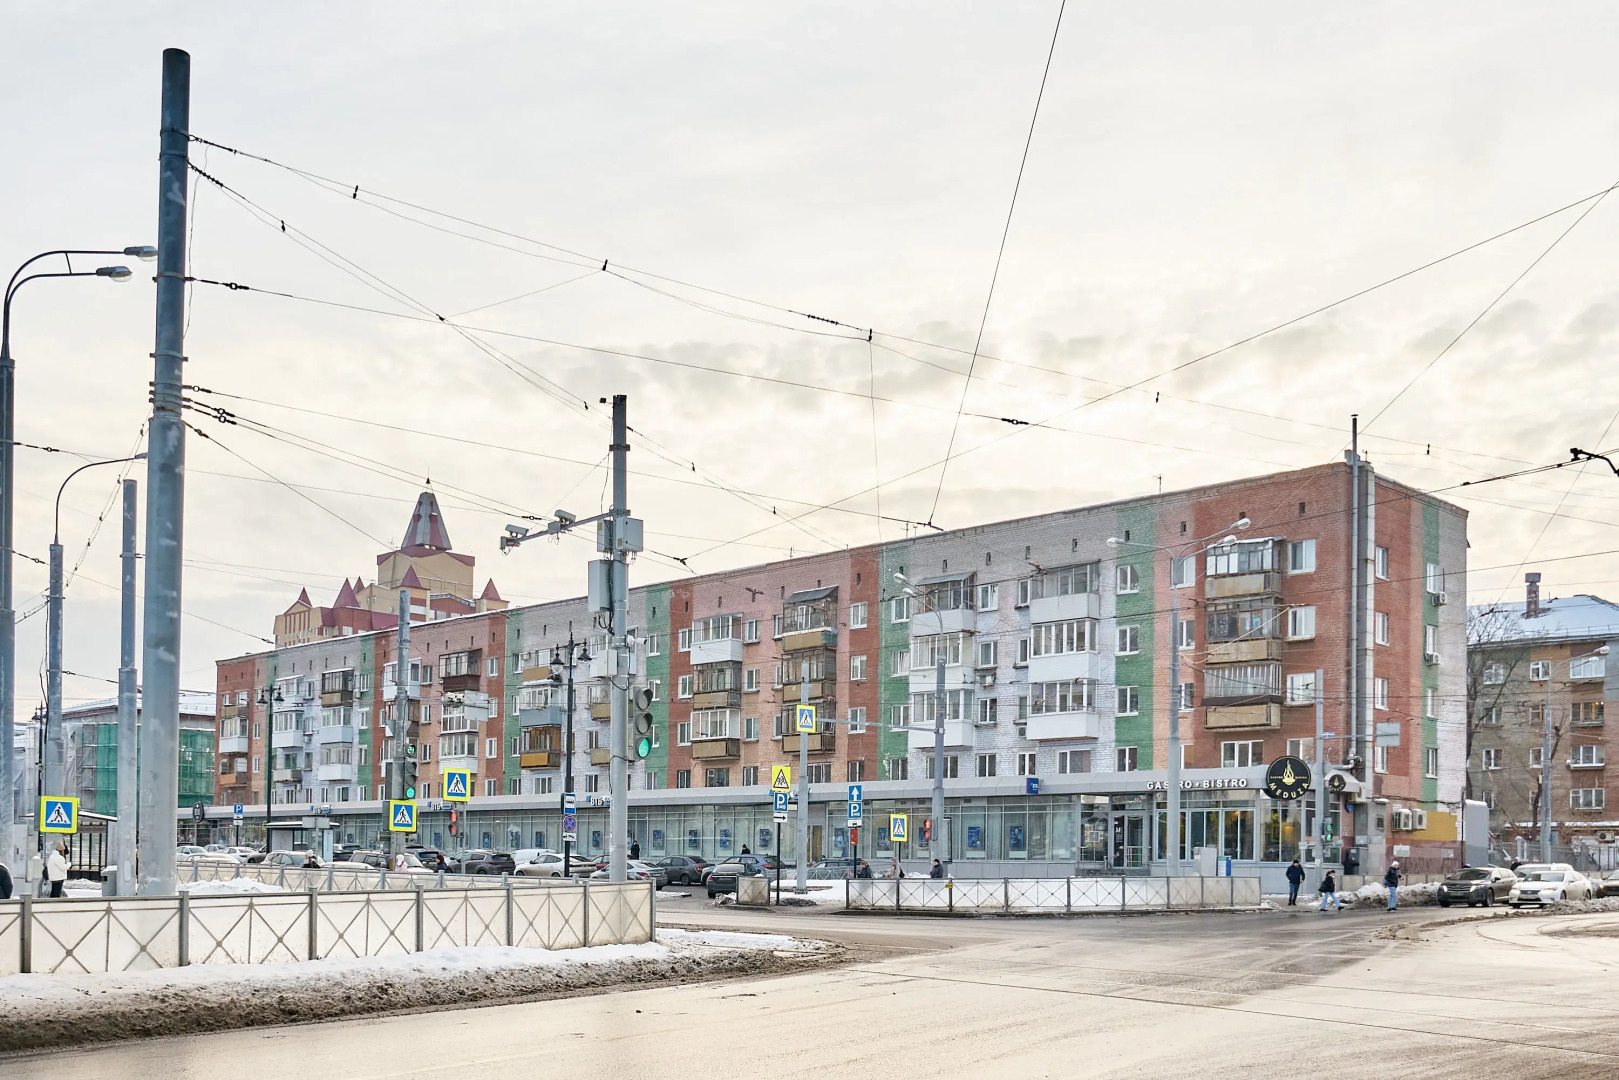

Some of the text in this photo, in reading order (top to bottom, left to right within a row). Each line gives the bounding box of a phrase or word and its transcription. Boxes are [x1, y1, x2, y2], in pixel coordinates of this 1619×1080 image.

[1147, 779, 1247, 789] GASRO BISTRO
[1269, 782, 1309, 798] MEDUZA
[777, 794, 785, 809] P
[851, 804, 859, 816] P
